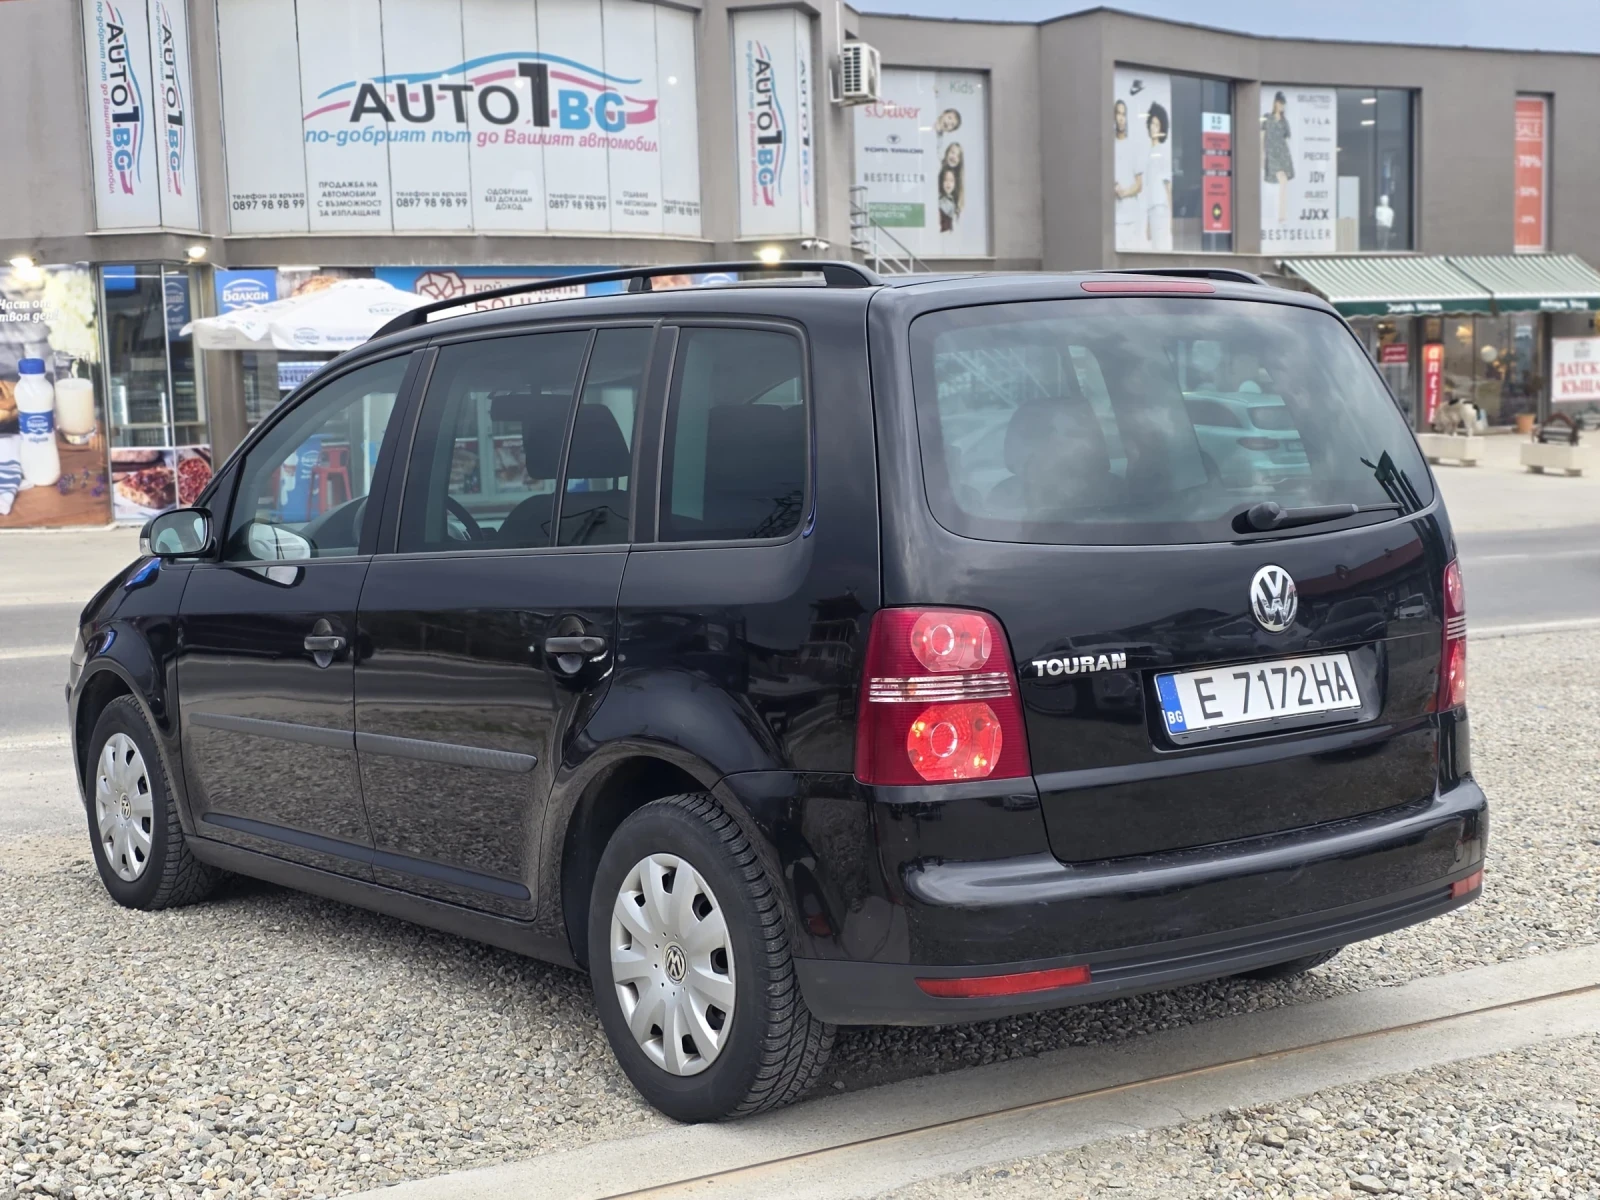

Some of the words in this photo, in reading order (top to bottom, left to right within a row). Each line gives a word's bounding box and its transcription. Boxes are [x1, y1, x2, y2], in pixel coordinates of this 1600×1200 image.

[1304, 117, 1330, 125] VILA
[305, 125, 425, 146] по-добрият
[432, 130, 471, 143] път
[477, 131, 499, 147] до
[504, 128, 575, 147] Вашият
[578, 132, 658, 152] автомобил
[864, 172, 926, 183] BESTSELLER
[318, 181, 365, 189] ПРОДАЖБА
[233, 200, 257, 211] 0897
[262, 200, 274, 210] 98
[278, 200, 290, 210] 98
[294, 199, 305, 209] 99
[325, 200, 381, 208] ВЪЗМОЖНОСТ
[396, 198, 420, 208] 0897
[424, 198, 437, 207] 98
[440, 198, 452, 207] 98
[456, 198, 468, 207] 99
[549, 199, 569, 209] 0897
[1299, 208, 1329, 221] JJXX
[1261, 229, 1331, 241] BESTSELLER
[223, 290, 269, 302] Балкан
[1032, 653, 1127, 677] TOURAN
[1194, 676, 1223, 720] E
[1168, 711, 1184, 725] BG
